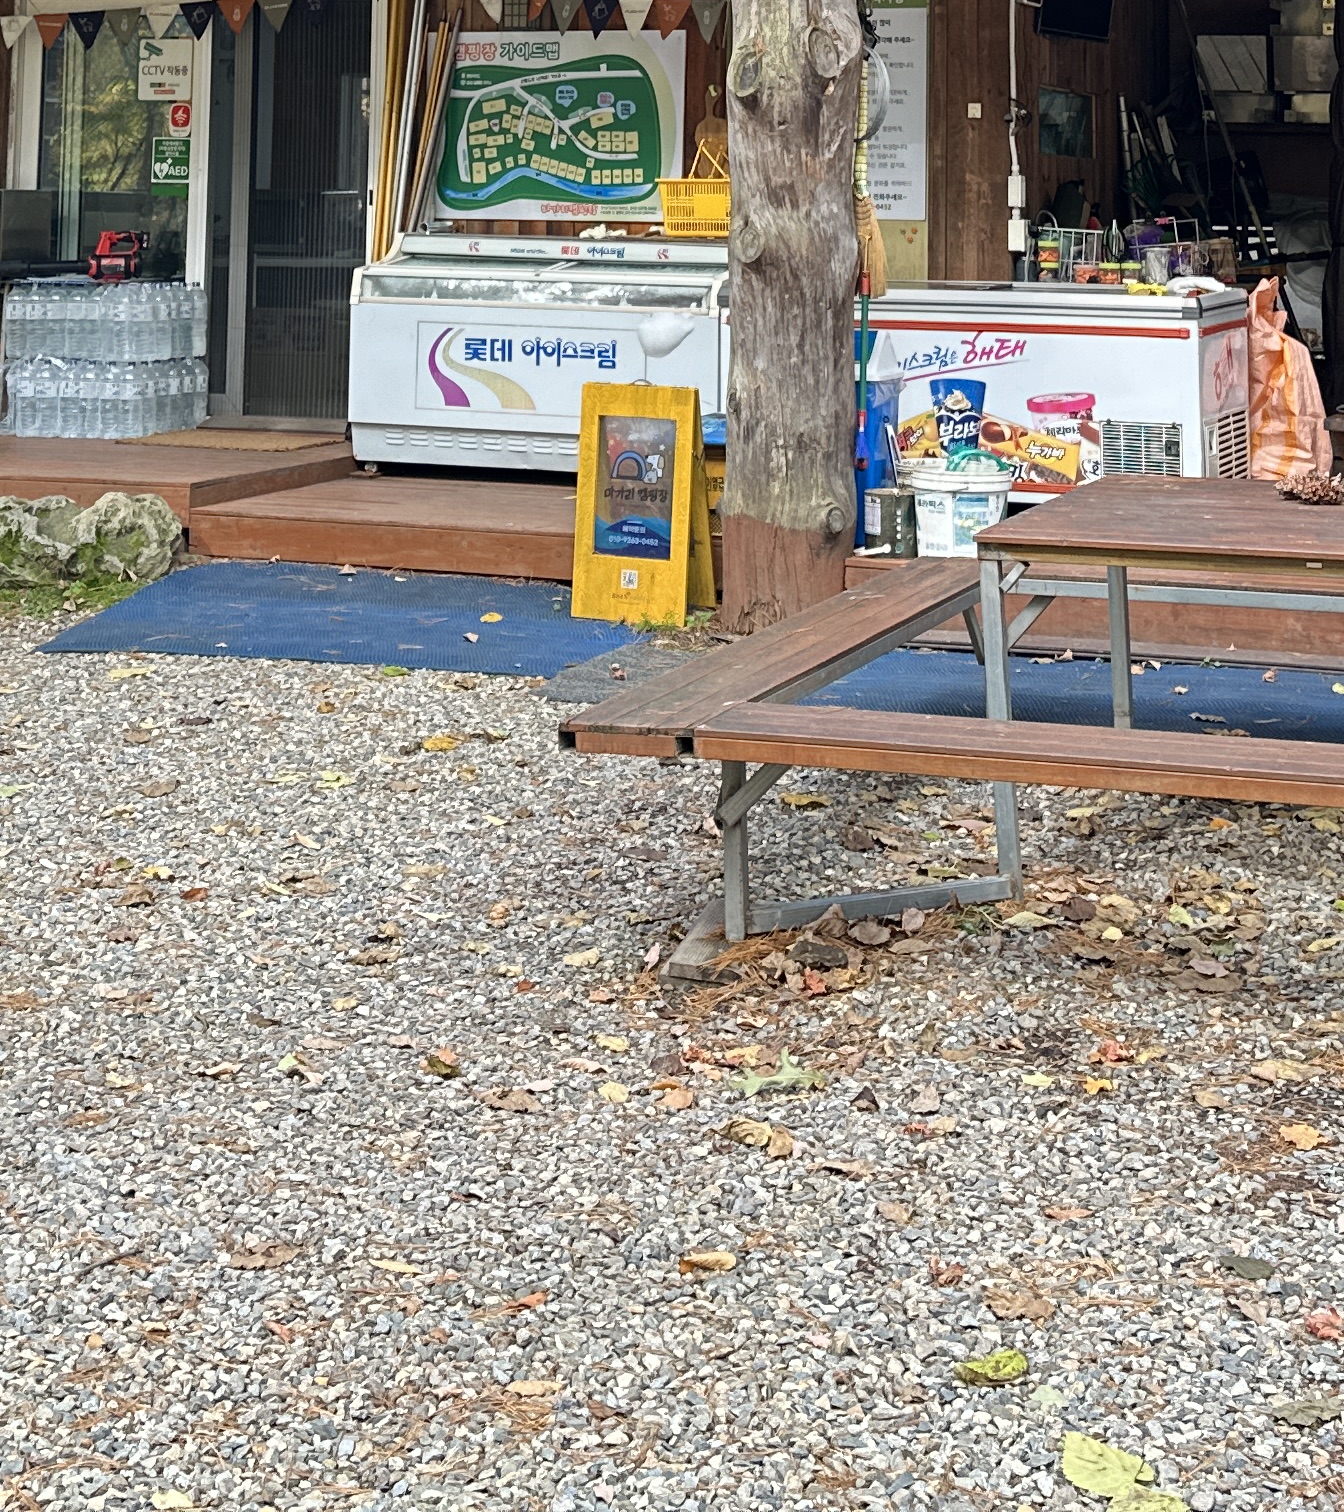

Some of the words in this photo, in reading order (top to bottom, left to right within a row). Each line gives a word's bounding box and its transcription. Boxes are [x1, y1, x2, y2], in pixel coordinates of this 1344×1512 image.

[500, 41, 560, 62] 가이드맵
[141, 65, 166, 76] CCTV
[167, 65, 189, 77] 작동중
[167, 165, 189, 177] AED
[464, 337, 513, 363] 롯데
[521, 336, 618, 370] 아이스크림
[961, 331, 1028, 365] 해태
[1024, 439, 1067, 461] 누가바
[603, 486, 635, 502] 마가리
[637, 488, 669, 503] 캠핑장
